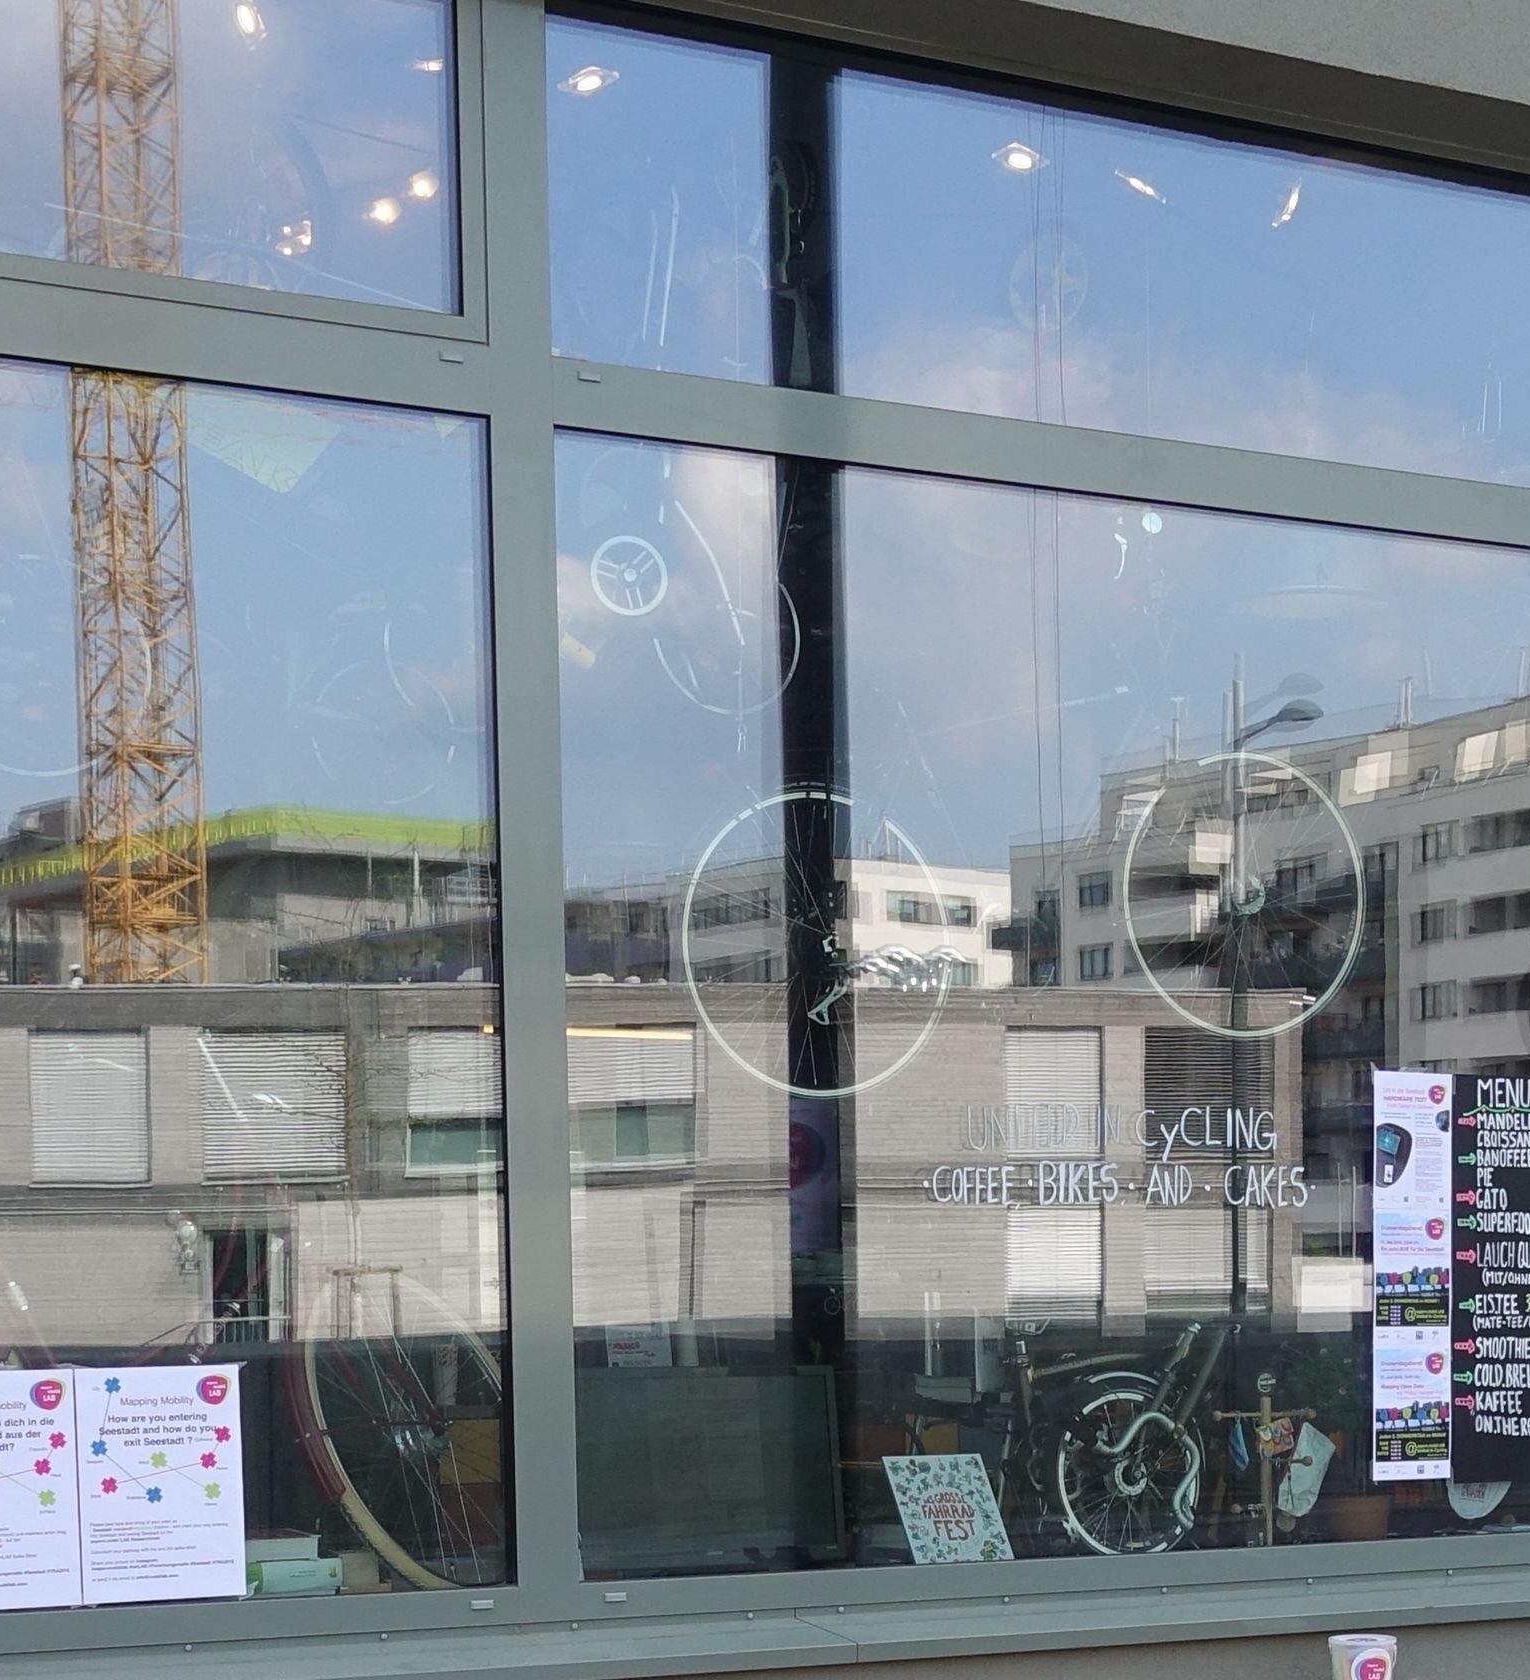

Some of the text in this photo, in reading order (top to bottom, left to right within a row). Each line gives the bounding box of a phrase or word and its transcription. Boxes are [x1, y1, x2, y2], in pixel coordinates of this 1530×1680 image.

[1477, 1168, 1493, 1187] PIE
[1146, 1164, 1192, 1204] AND
[1223, 1165, 1308, 1208] CAKES
[1477, 1242, 1515, 1268] LAUCH
[120, 1396, 194, 1407] Mapping Mobility
[1476, 1391, 1523, 1414] KAFFEE
[4, 1418, 25, 1427] dich
[28, 1418, 37, 1426] in
[40, 1417, 55, 1426] die
[108, 1415, 128, 1423] How
[149, 1415, 166, 1424] you
[169, 1413, 207, 1423] entering
[26, 1430, 41, 1438] der
[99, 1424, 217, 1436] Seestadt and how do you
[124, 1438, 141, 1446] exit
[144, 1436, 184, 1446] Seestadt
[921, 1504, 976, 1519] FAHRRAD
[933, 1520, 975, 1540] FEST
